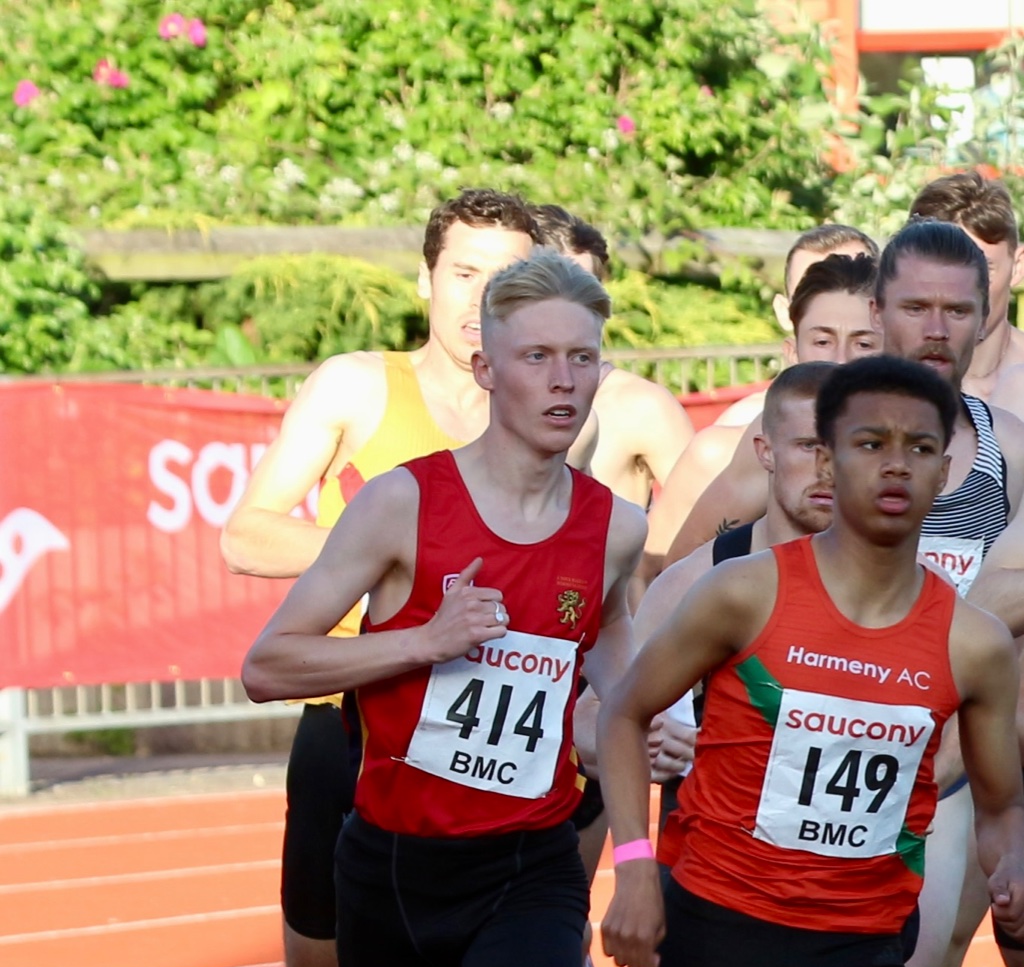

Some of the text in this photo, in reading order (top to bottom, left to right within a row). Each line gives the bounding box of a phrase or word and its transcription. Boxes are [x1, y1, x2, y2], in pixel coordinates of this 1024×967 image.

[464, 645, 570, 683] aucony
[787, 646, 931, 690] Harmeny AC
[446, 678, 547, 752] 414
[785, 708, 926, 747] saucony
[449, 751, 517, 785] BMC
[797, 747, 899, 814] 149
[798, 820, 868, 848] BMC
